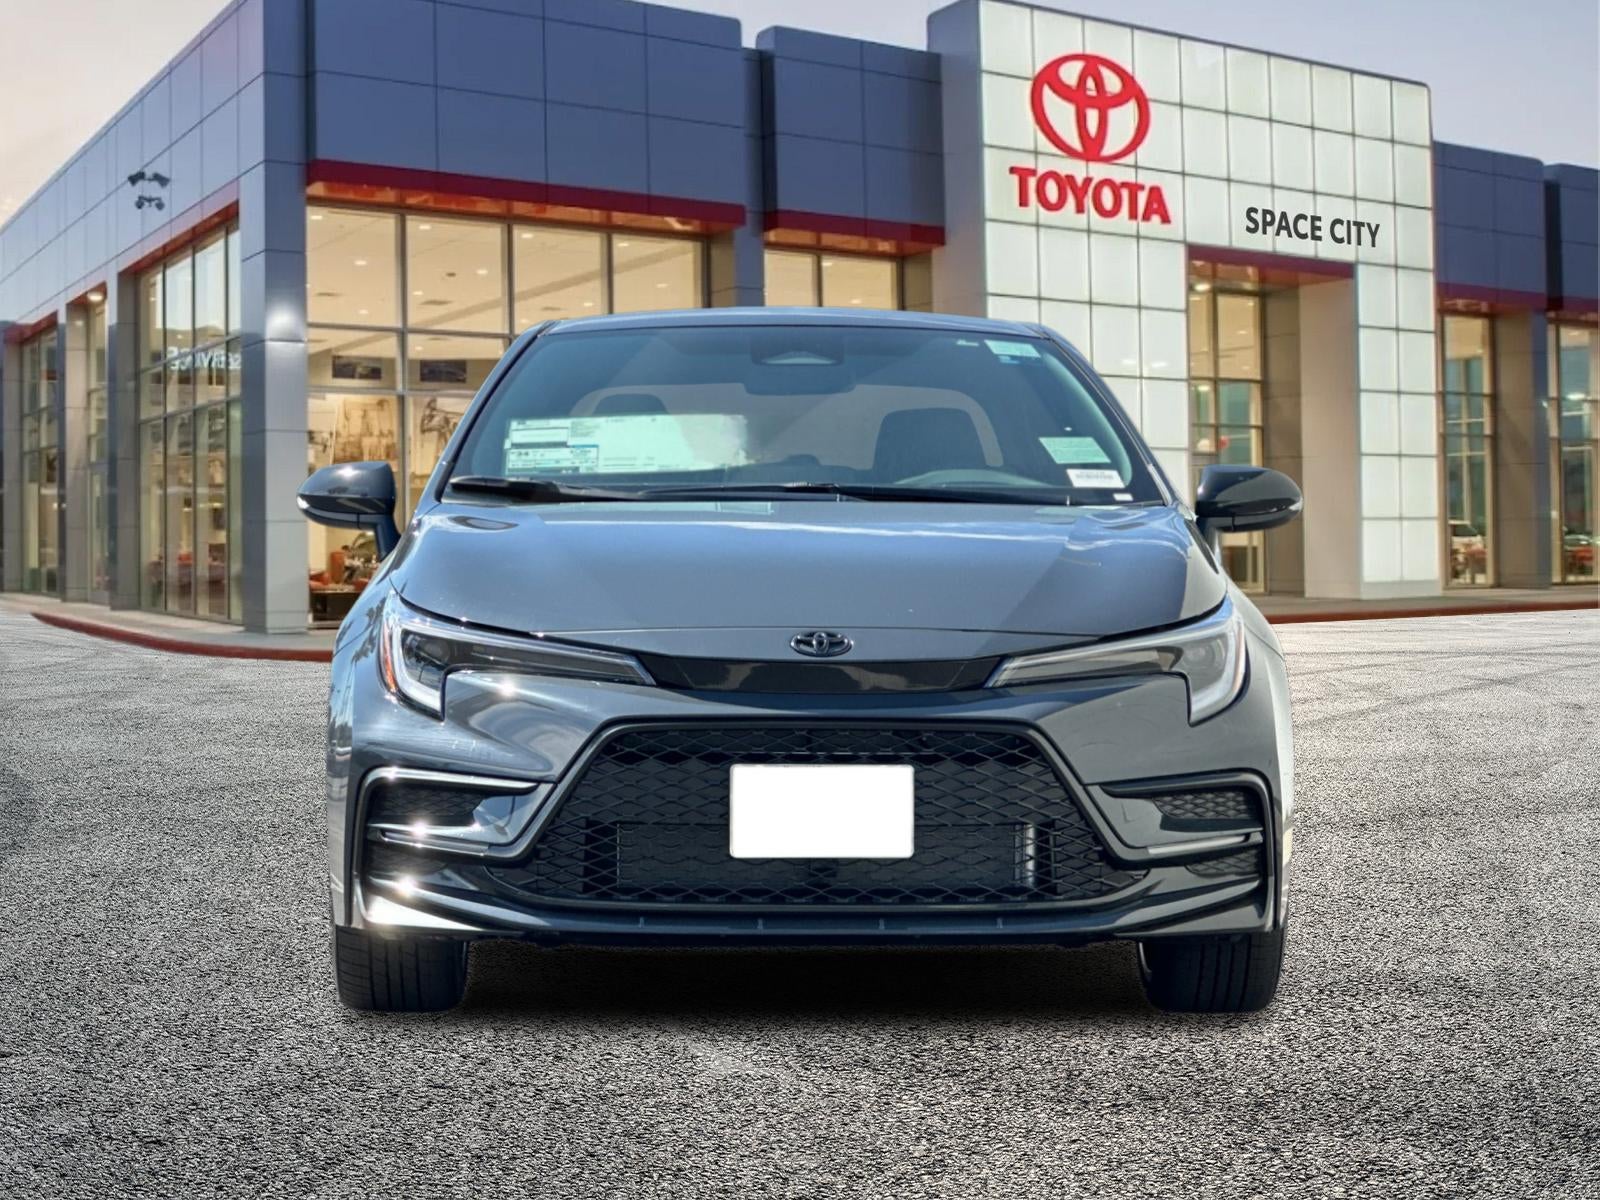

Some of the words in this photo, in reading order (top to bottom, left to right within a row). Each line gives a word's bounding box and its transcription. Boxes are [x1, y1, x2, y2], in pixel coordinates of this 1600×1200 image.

[1009, 166, 1171, 224] TOYOTA
[1245, 206, 1322, 241] SPACE
[1329, 218, 1380, 248] CITY
